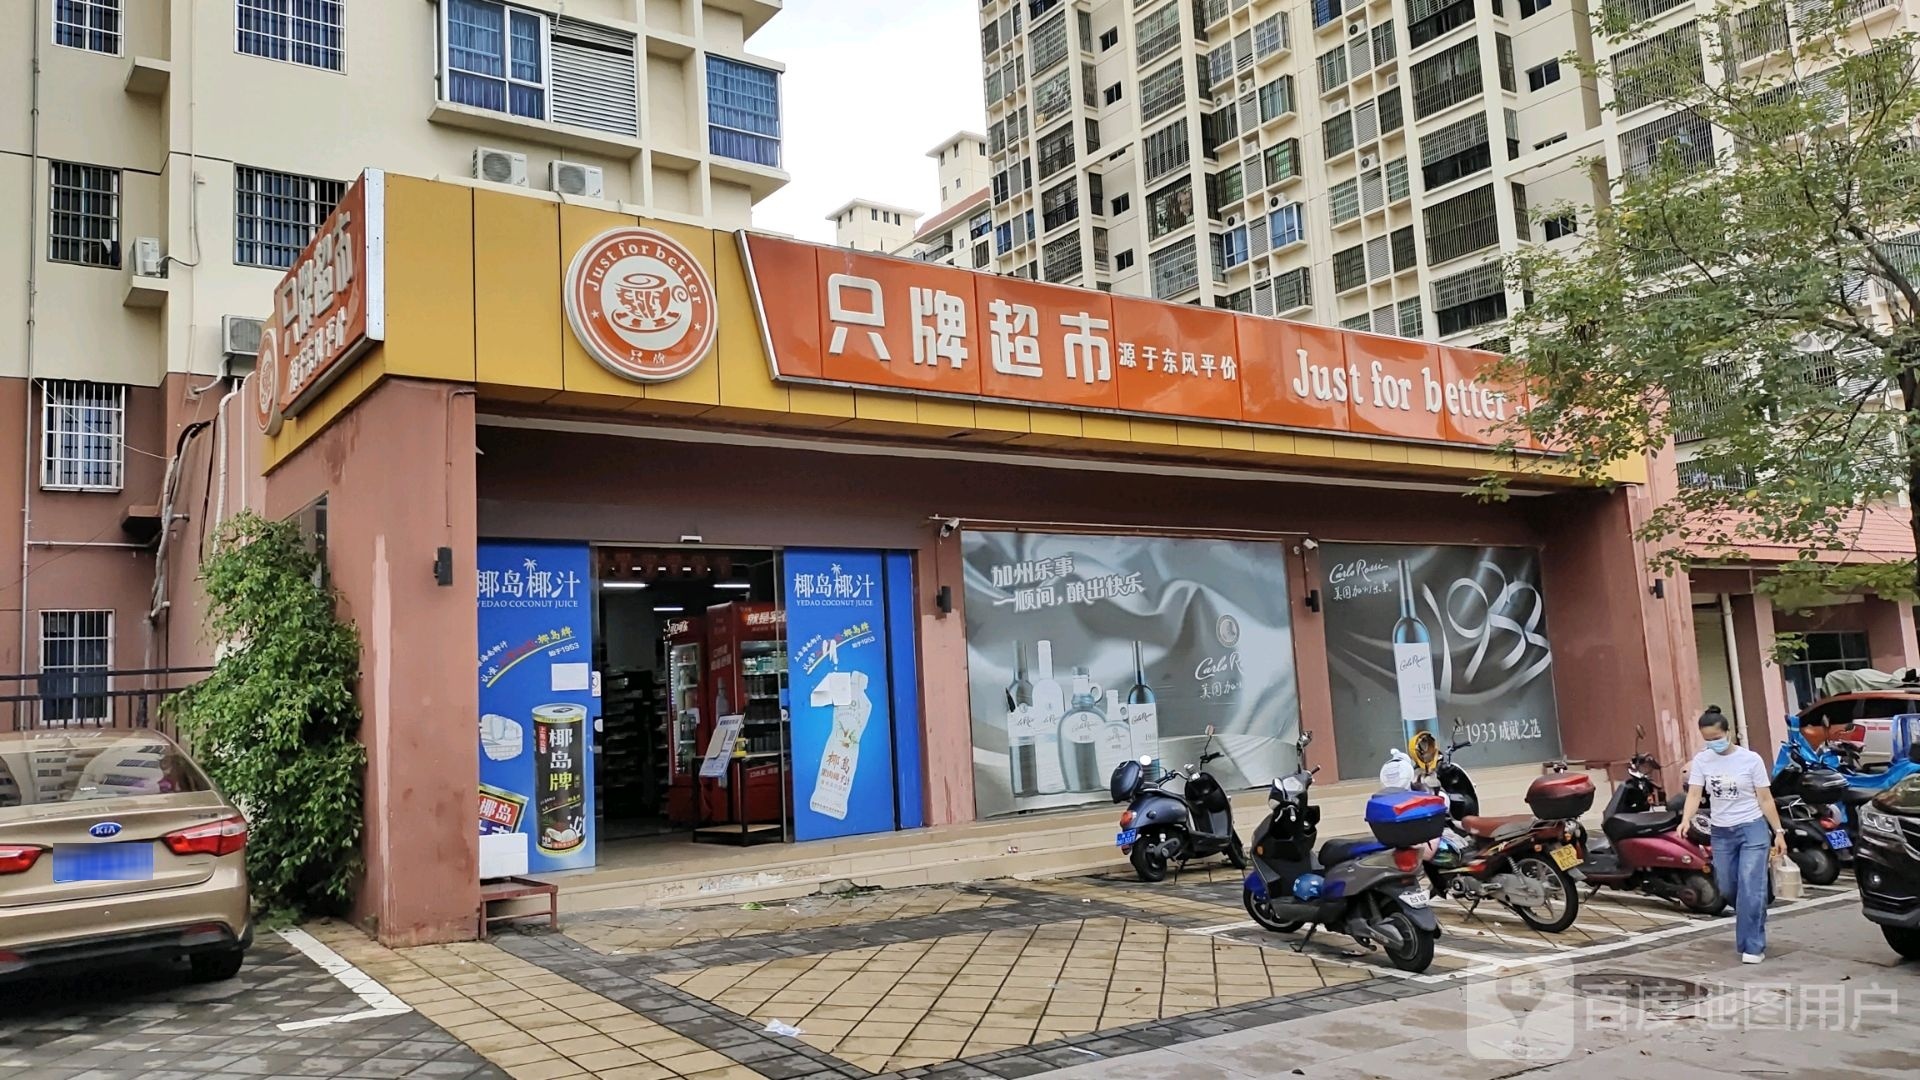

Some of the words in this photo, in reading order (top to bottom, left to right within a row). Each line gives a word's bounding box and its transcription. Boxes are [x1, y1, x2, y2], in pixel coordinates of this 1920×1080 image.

[282, 210, 354, 358] 只牌超市
[586, 250, 618, 292] Just
[618, 242, 649, 257] for
[655, 245, 702, 304] better
[827, 273, 1113, 384] 只牌超市
[1117, 341, 1239, 382] 源于东风平价
[1293, 348, 1364, 406] Just
[1370, 360, 1411, 412] for
[1421, 366, 1508, 421] better
[793, 572, 875, 598] 椰岛椰汁
[991, 555, 1075, 588] 加州乐事
[1329, 563, 1355, 584] Carlo
[508, 599, 553, 608] COCONUT
[554, 600, 578, 609] JUICE
[821, 599, 854, 607] COCONUT
[855, 600, 874, 608] JUICE
[1195, 655, 1228, 682] Carlo
[1465, 722, 1497, 744] 1933
[1499, 718, 1542, 742] 成就之选
[549, 728, 574, 792] 椰岛牌
[95, 825, 117, 835] KIA
